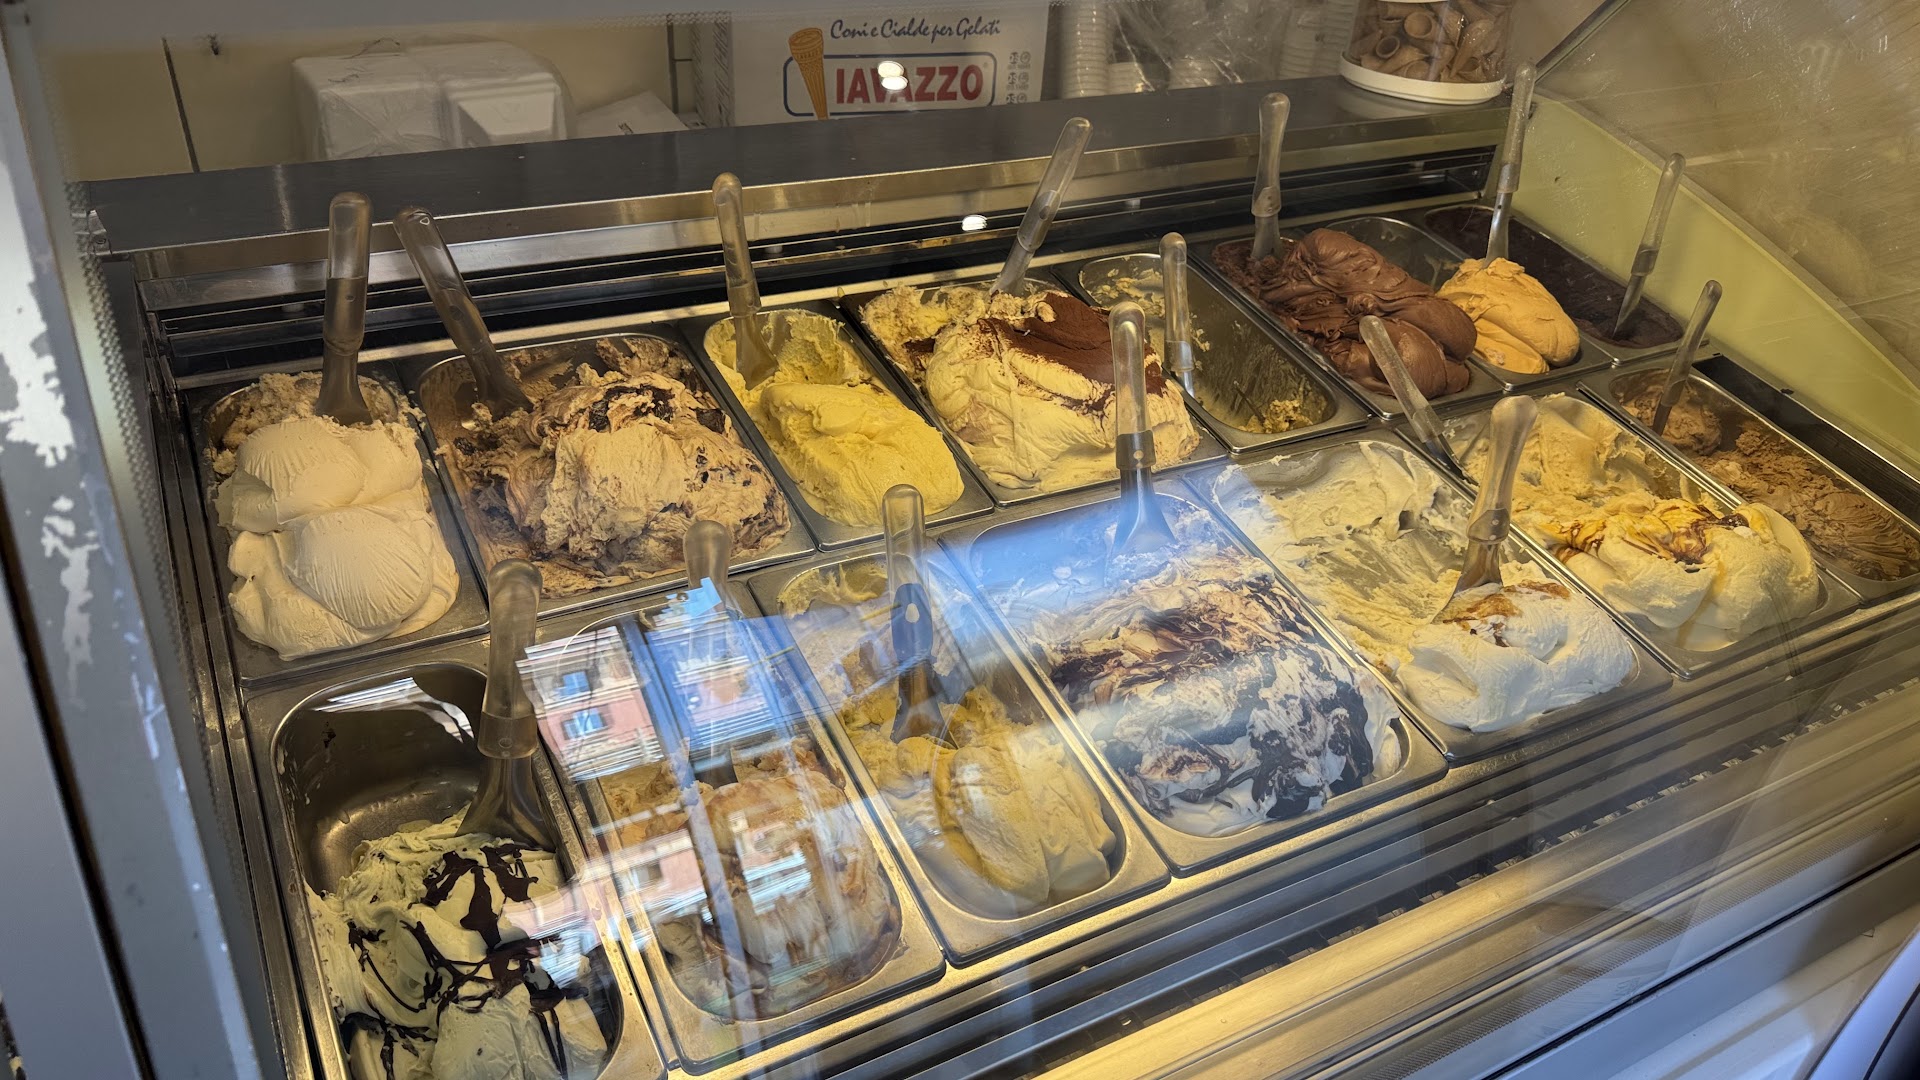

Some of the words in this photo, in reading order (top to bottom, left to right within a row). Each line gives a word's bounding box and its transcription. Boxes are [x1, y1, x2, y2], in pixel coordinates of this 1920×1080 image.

[830, 18, 868, 39] Coni
[880, 16, 928, 39] Cialde
[931, 23, 954, 44] per
[956, 15, 1001, 40] Gelati
